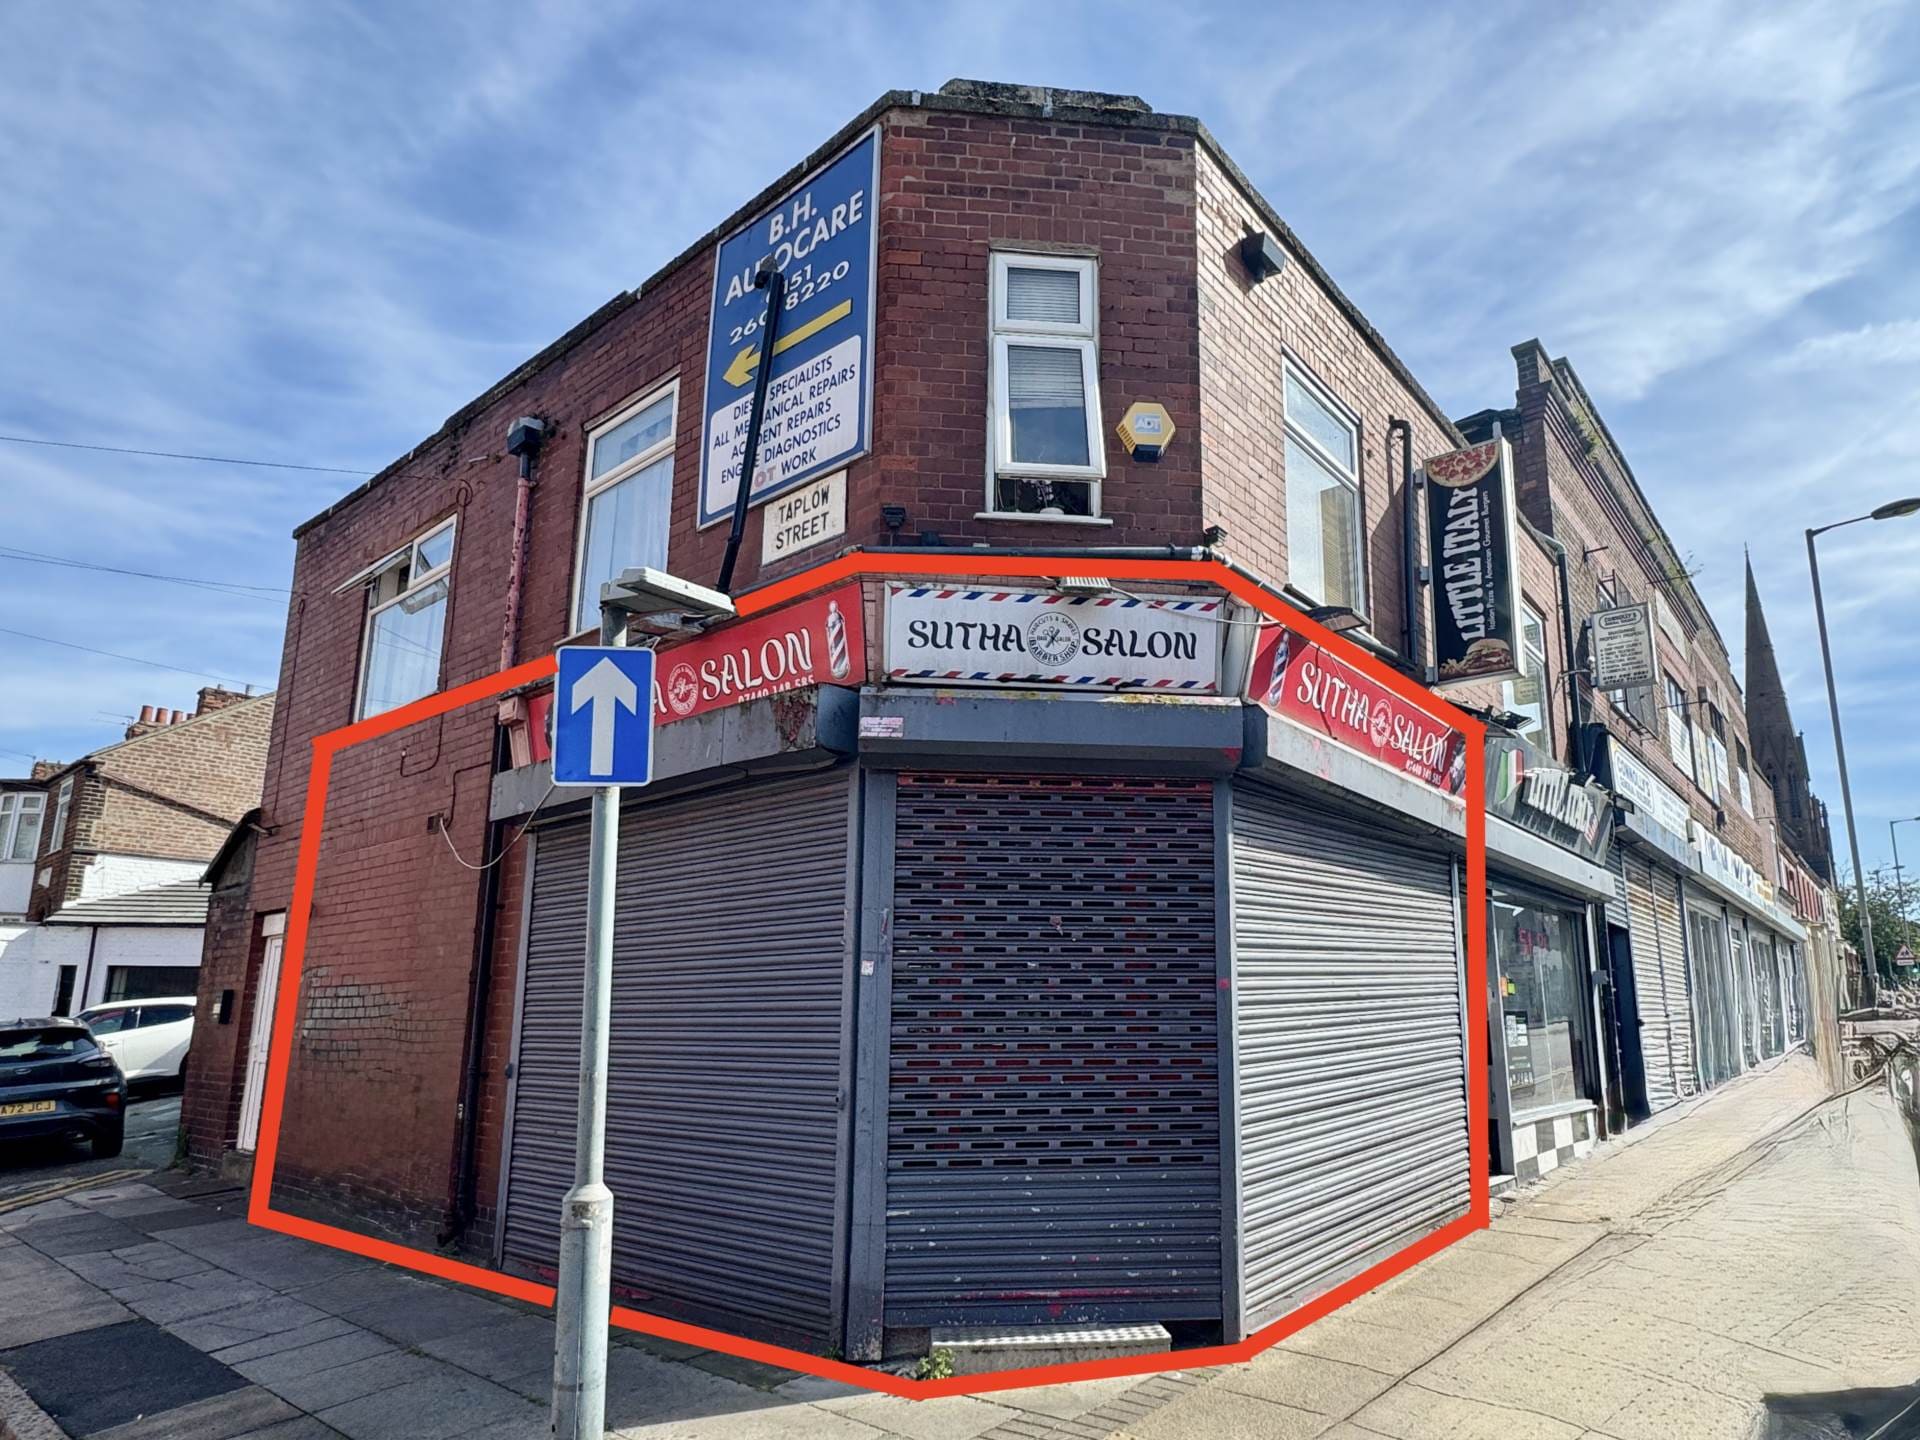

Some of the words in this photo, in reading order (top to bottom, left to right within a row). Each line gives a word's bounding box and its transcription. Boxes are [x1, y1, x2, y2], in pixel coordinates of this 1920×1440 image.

[724, 189, 863, 306] AUOCARE
[769, 192, 817, 245] B.H.
[766, 264, 812, 304] 151
[785, 261, 850, 310] 8220
[713, 430, 730, 450] ALL
[733, 392, 805, 440] MEANICAL
[809, 364, 855, 401] REPAIRS
[733, 397, 755, 421] DIES
[769, 355, 833, 402] SPECIALISTS
[721, 452, 760, 484] ENGE
[764, 413, 841, 464] DIAGNOSTICS
[731, 421, 783, 460] ACDENT
[787, 397, 832, 433] REPAIRS
[754, 465, 777, 488] OT
[781, 446, 817, 475] WORK
[776, 511, 829, 549] STREET
[779, 484, 830, 524] TAPLOW
[1443, 487, 1482, 558] ITALY
[1443, 557, 1486, 642] LITTLE
[700, 627, 814, 702] SALON
[907, 619, 1026, 653] SUTHA
[1082, 627, 1198, 660] SALON
[1295, 661, 1369, 734] SUTHA
[1391, 714, 1449, 773] SALON
[1526, 768, 1569, 822] LITTLE
